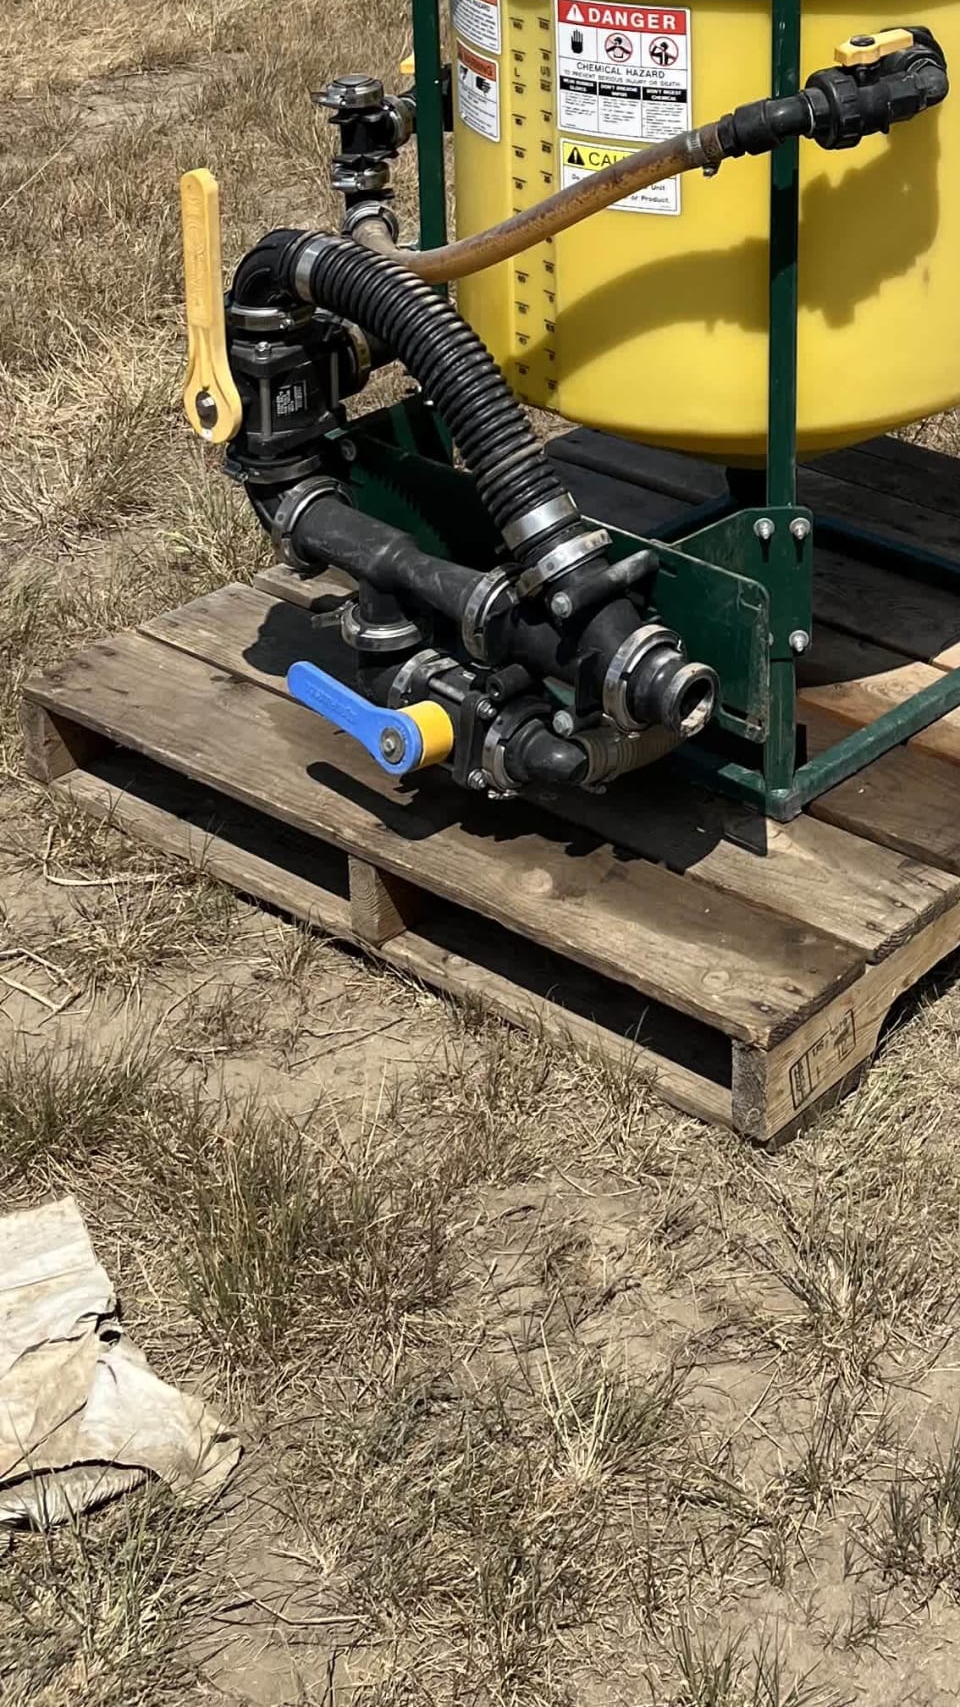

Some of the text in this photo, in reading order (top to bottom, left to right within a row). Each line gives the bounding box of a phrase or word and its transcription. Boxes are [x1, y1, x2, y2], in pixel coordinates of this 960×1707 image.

[588, 7, 676, 30] DANGER
[576, 62, 665, 79] CHEMICAL HAZARD
